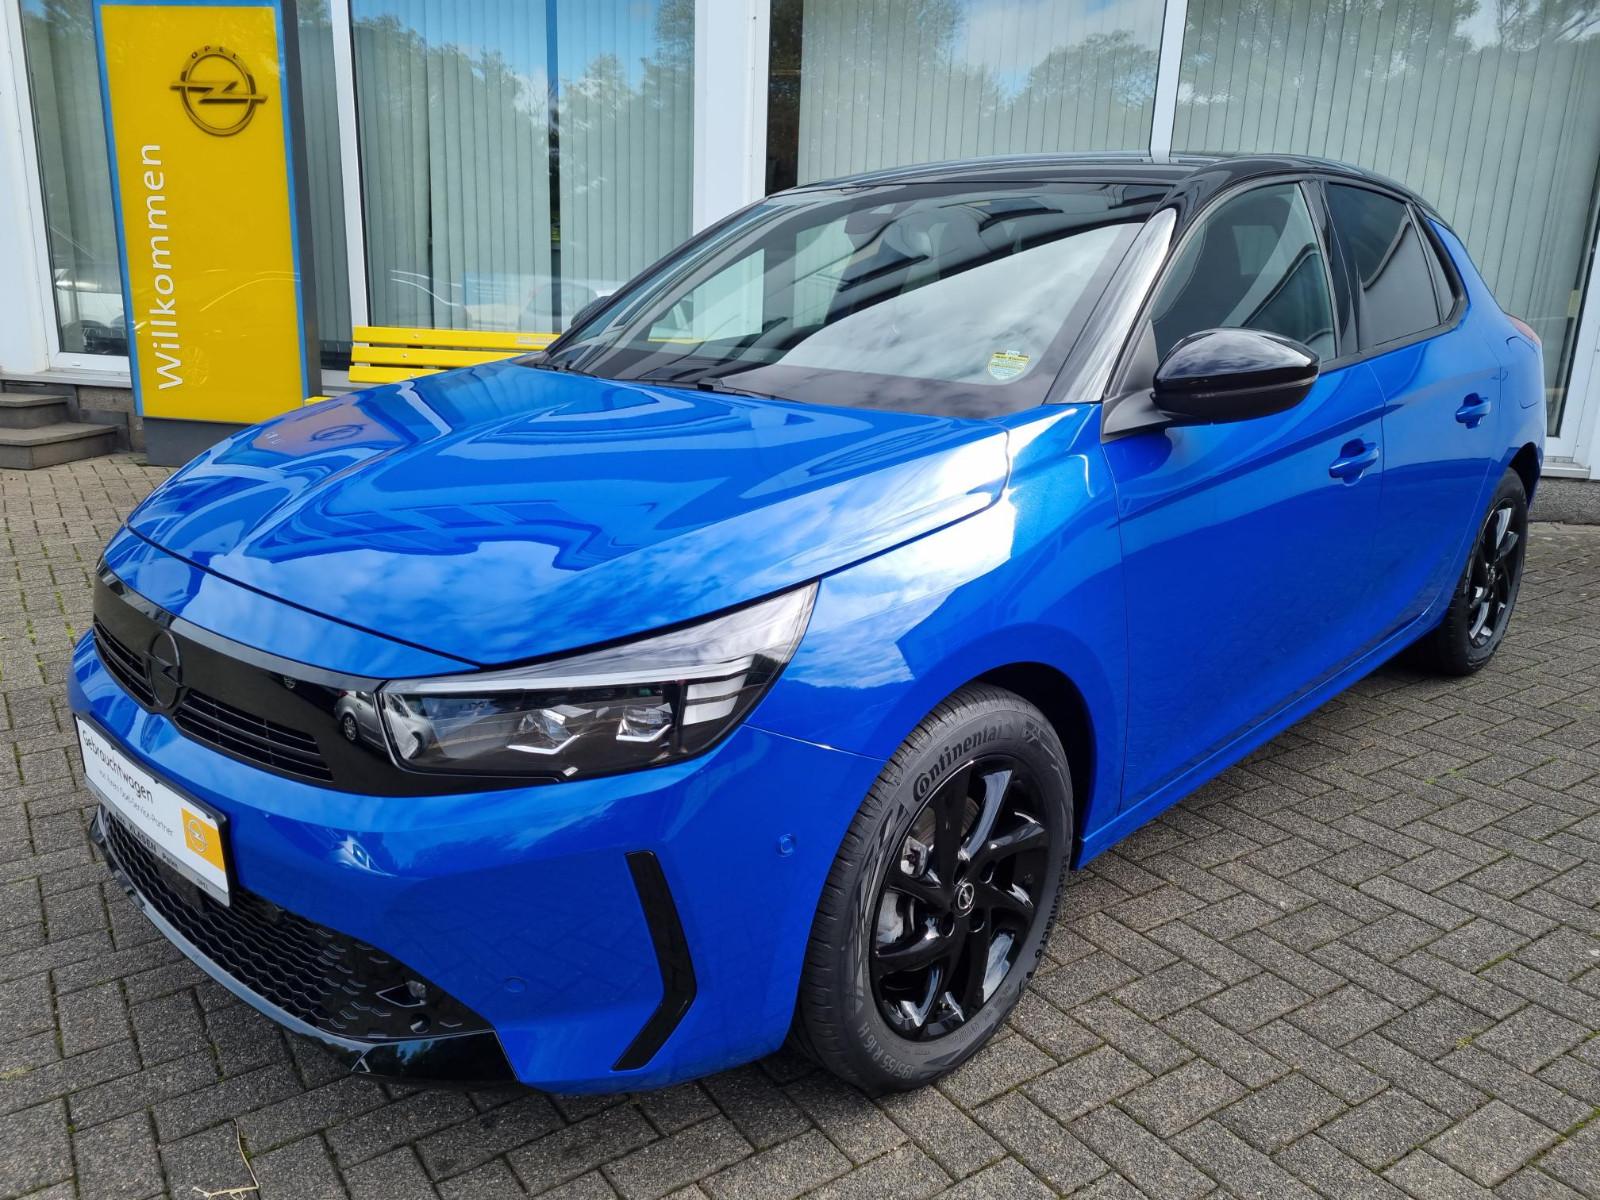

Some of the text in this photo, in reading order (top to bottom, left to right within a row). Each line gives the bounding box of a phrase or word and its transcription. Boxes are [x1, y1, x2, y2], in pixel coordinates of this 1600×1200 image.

[191, 45, 239, 60] OPEL
[142, 144, 184, 390] Willkommen
[82, 729, 154, 805] Gebrauchtwagen
[913, 724, 1003, 802] Continental
[857, 1022, 914, 1079] 195/55 R 16 H
